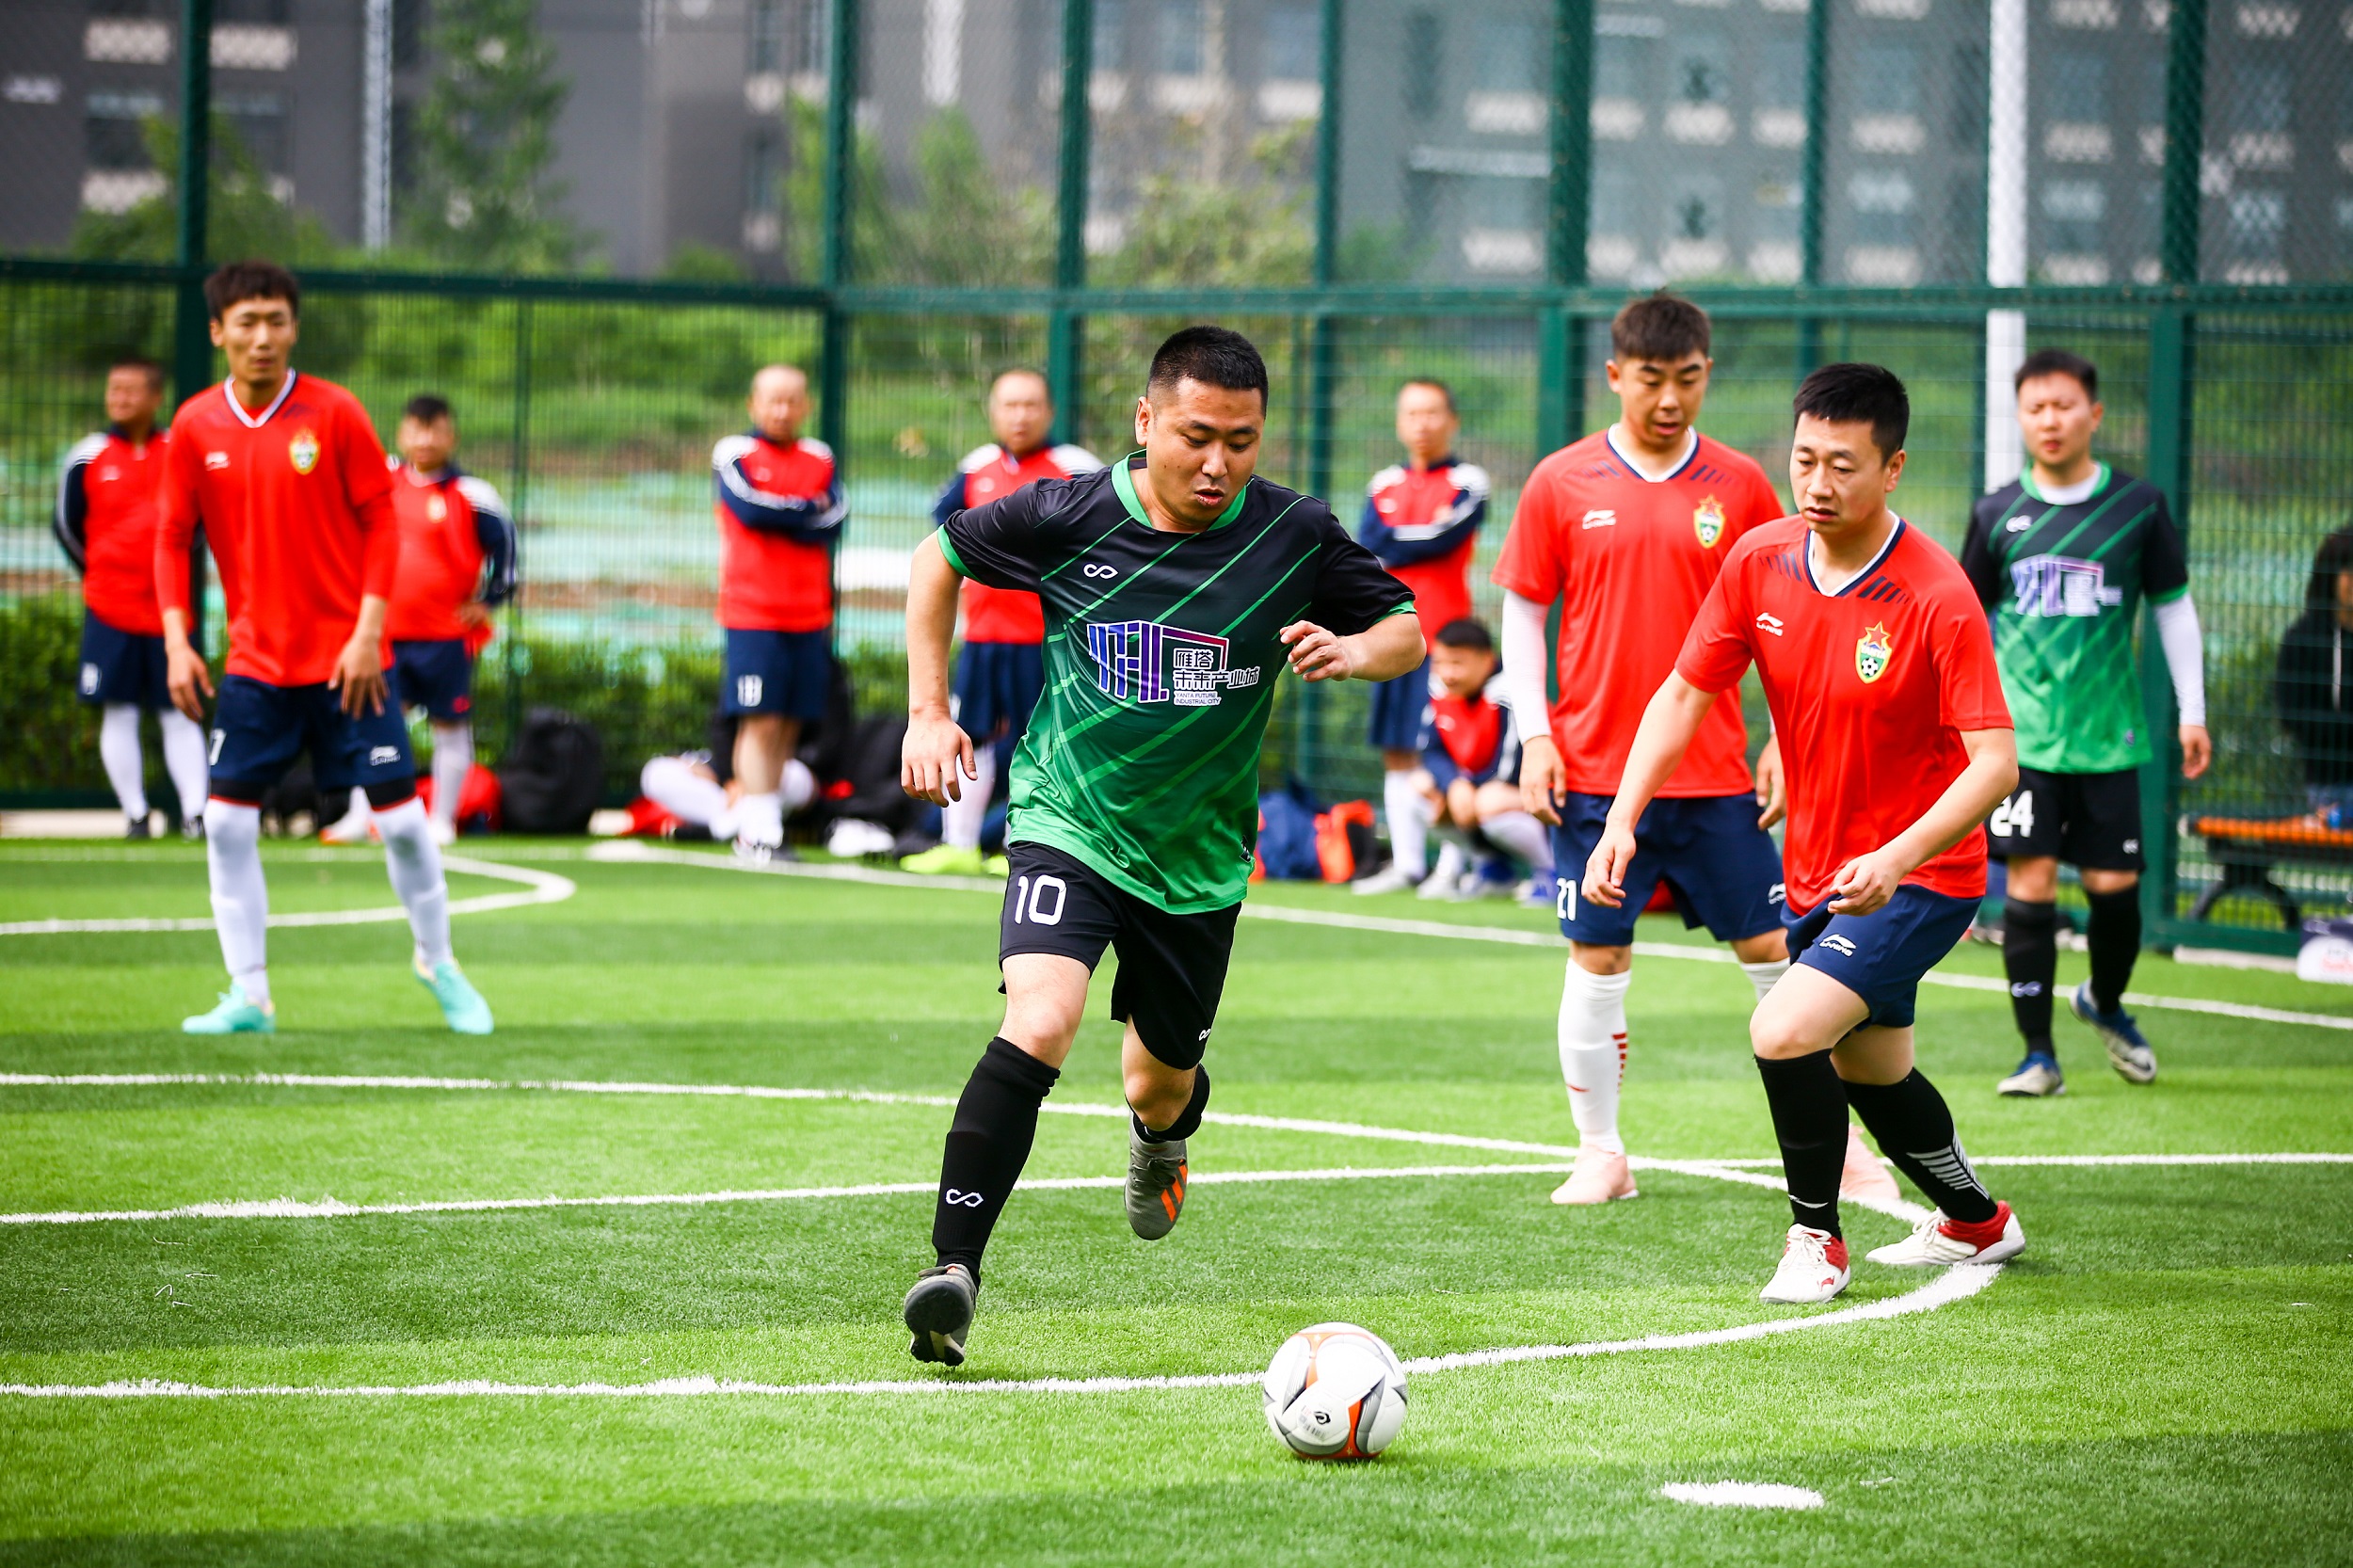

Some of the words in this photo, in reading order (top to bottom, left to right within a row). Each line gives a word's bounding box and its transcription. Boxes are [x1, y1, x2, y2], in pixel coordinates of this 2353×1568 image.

[1175, 649, 1213, 668] 雁塔
[1175, 667, 1259, 688] 未来产业城
[1990, 790, 2034, 838] 24
[1015, 874, 1067, 926] 10
[1556, 877, 1577, 921] 21
